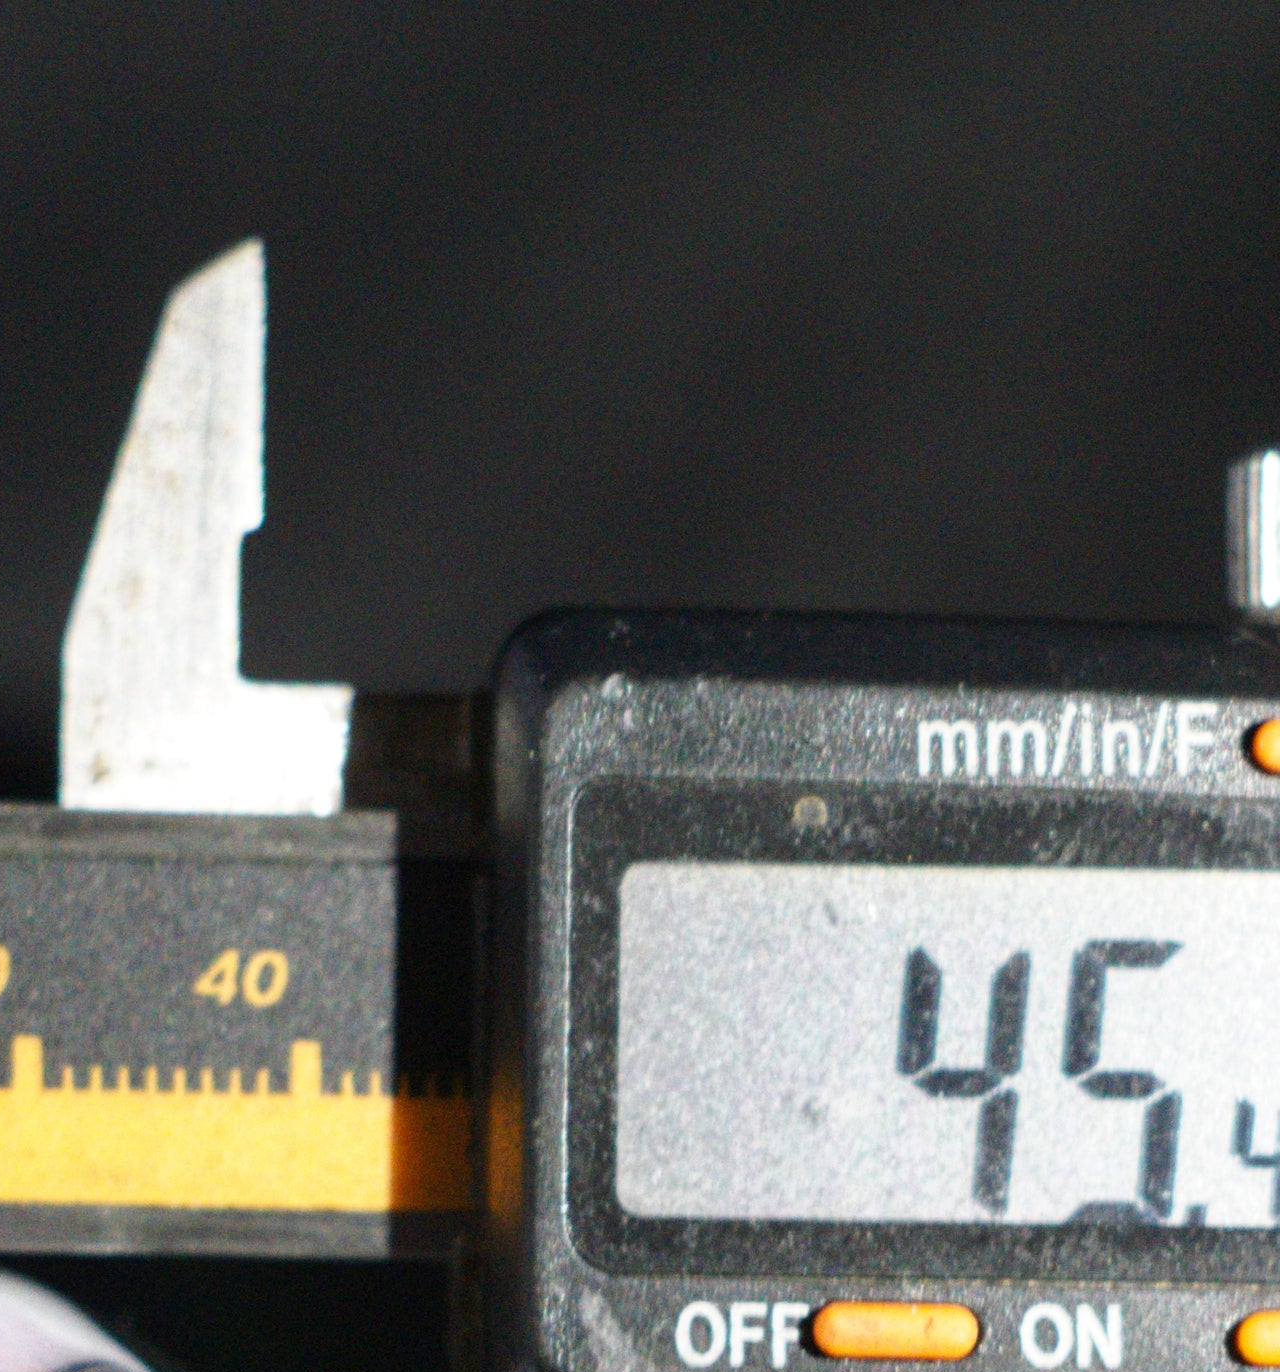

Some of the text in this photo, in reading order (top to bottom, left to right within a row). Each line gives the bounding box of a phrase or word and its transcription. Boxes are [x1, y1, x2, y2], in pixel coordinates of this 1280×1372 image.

[918, 703, 1219, 779] mm/in/F
[195, 949, 288, 1009] 40
[674, 1300, 810, 1369] OFF
[1019, 1303, 1123, 1369] ON
